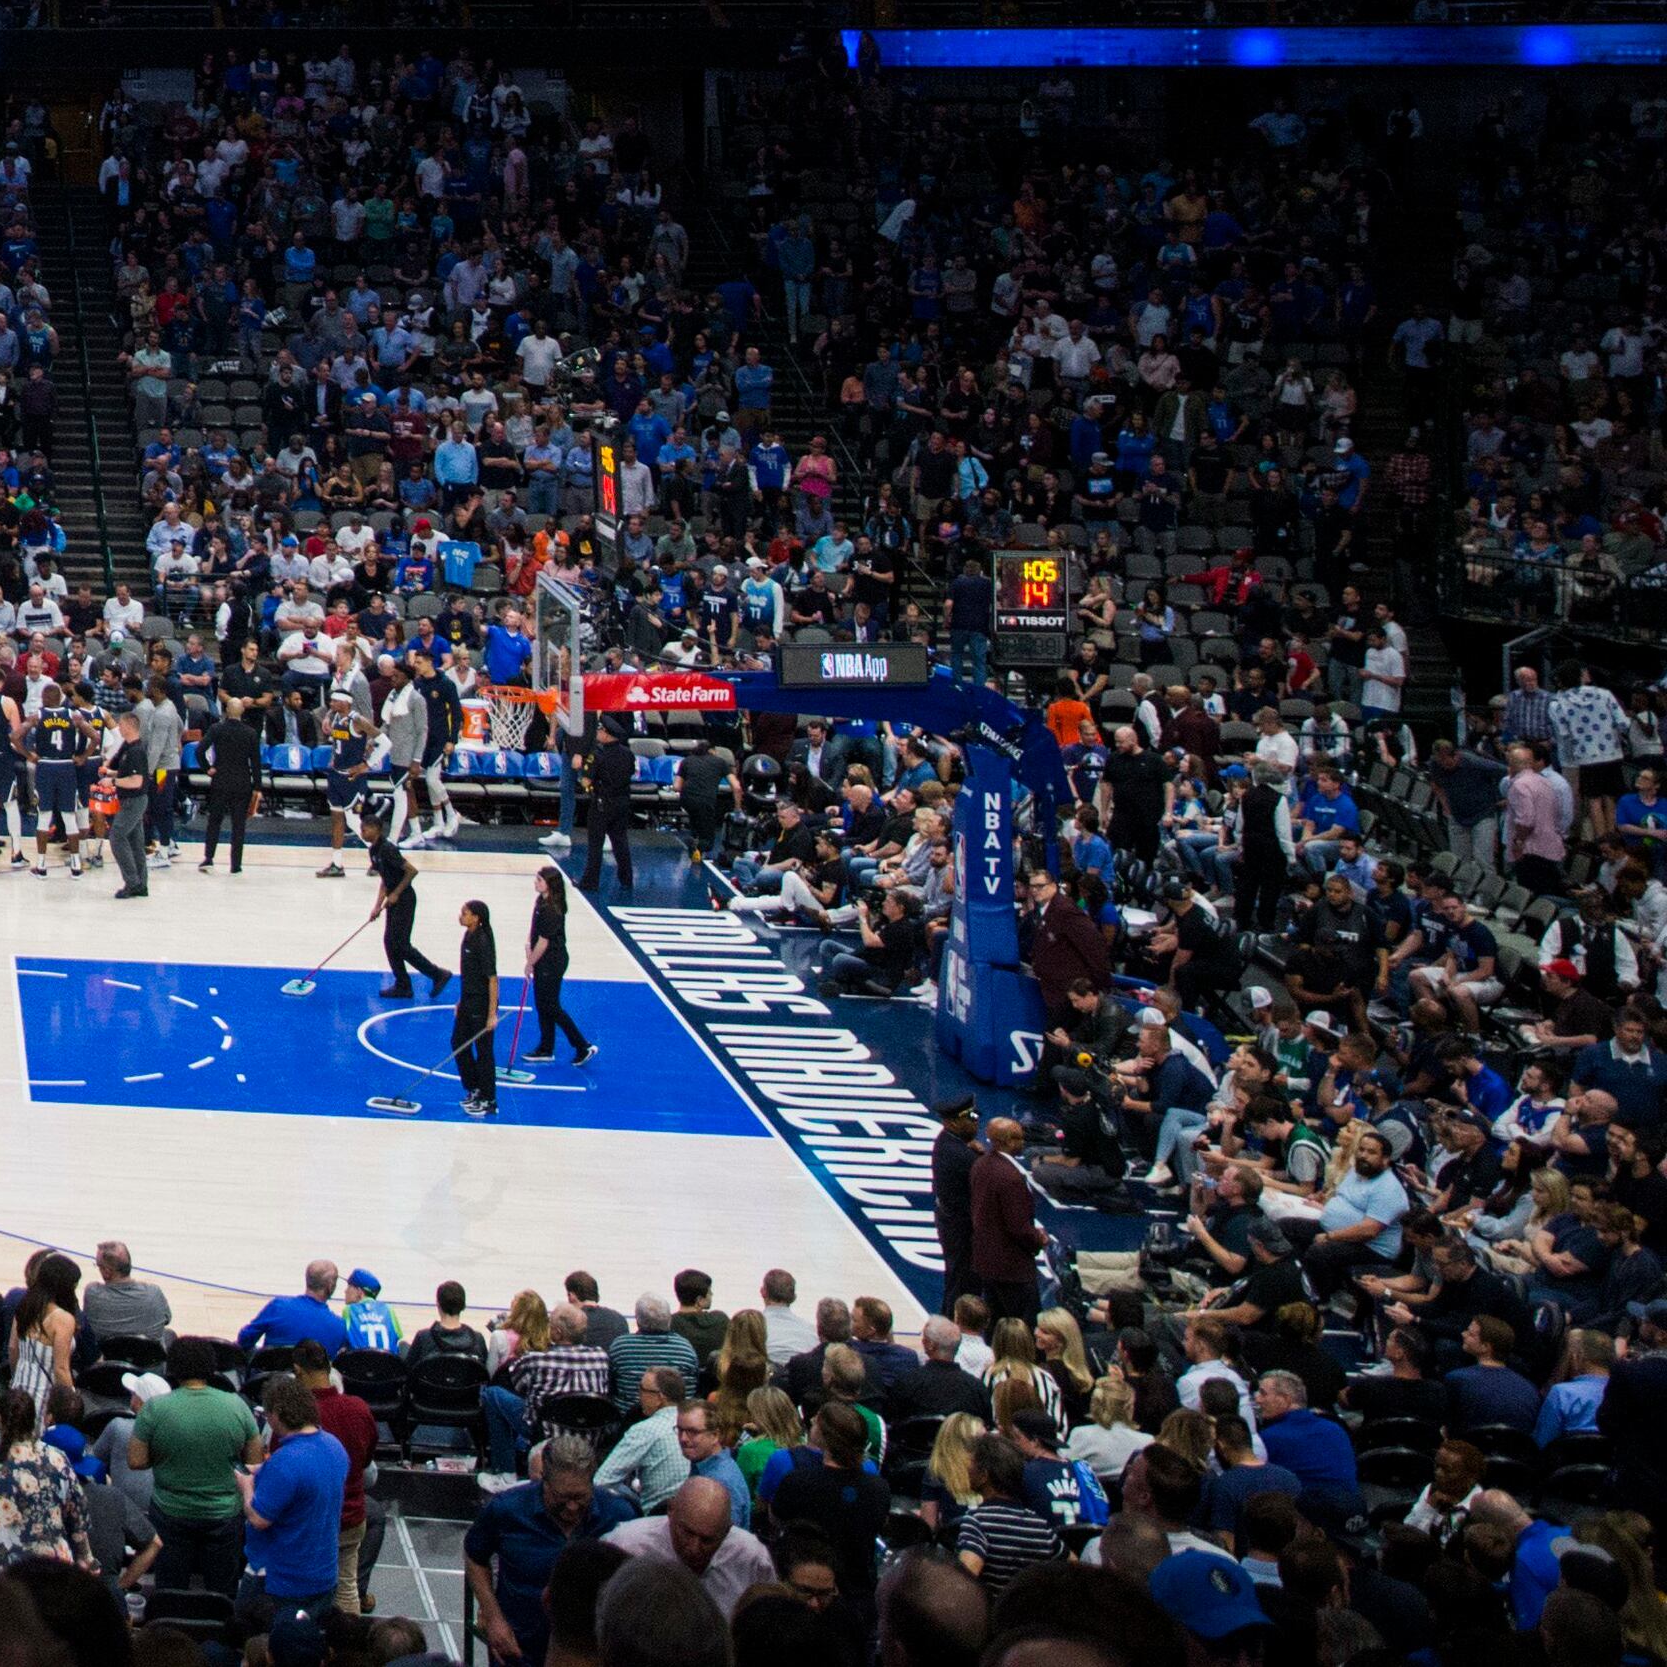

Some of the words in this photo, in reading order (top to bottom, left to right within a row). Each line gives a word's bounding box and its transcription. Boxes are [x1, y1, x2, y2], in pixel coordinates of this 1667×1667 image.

[1024, 560, 1057, 583] 1:05
[1025, 584, 1048, 607] 14
[1018, 615, 1065, 627] TISSOT
[835, 654, 863, 677] NBA
[864, 655, 887, 682] App
[51, 730, 63, 751] 4
[984, 792, 1001, 850] NBA
[984, 857, 1001, 895] TV
[608, 905, 832, 1016] DALLAS
